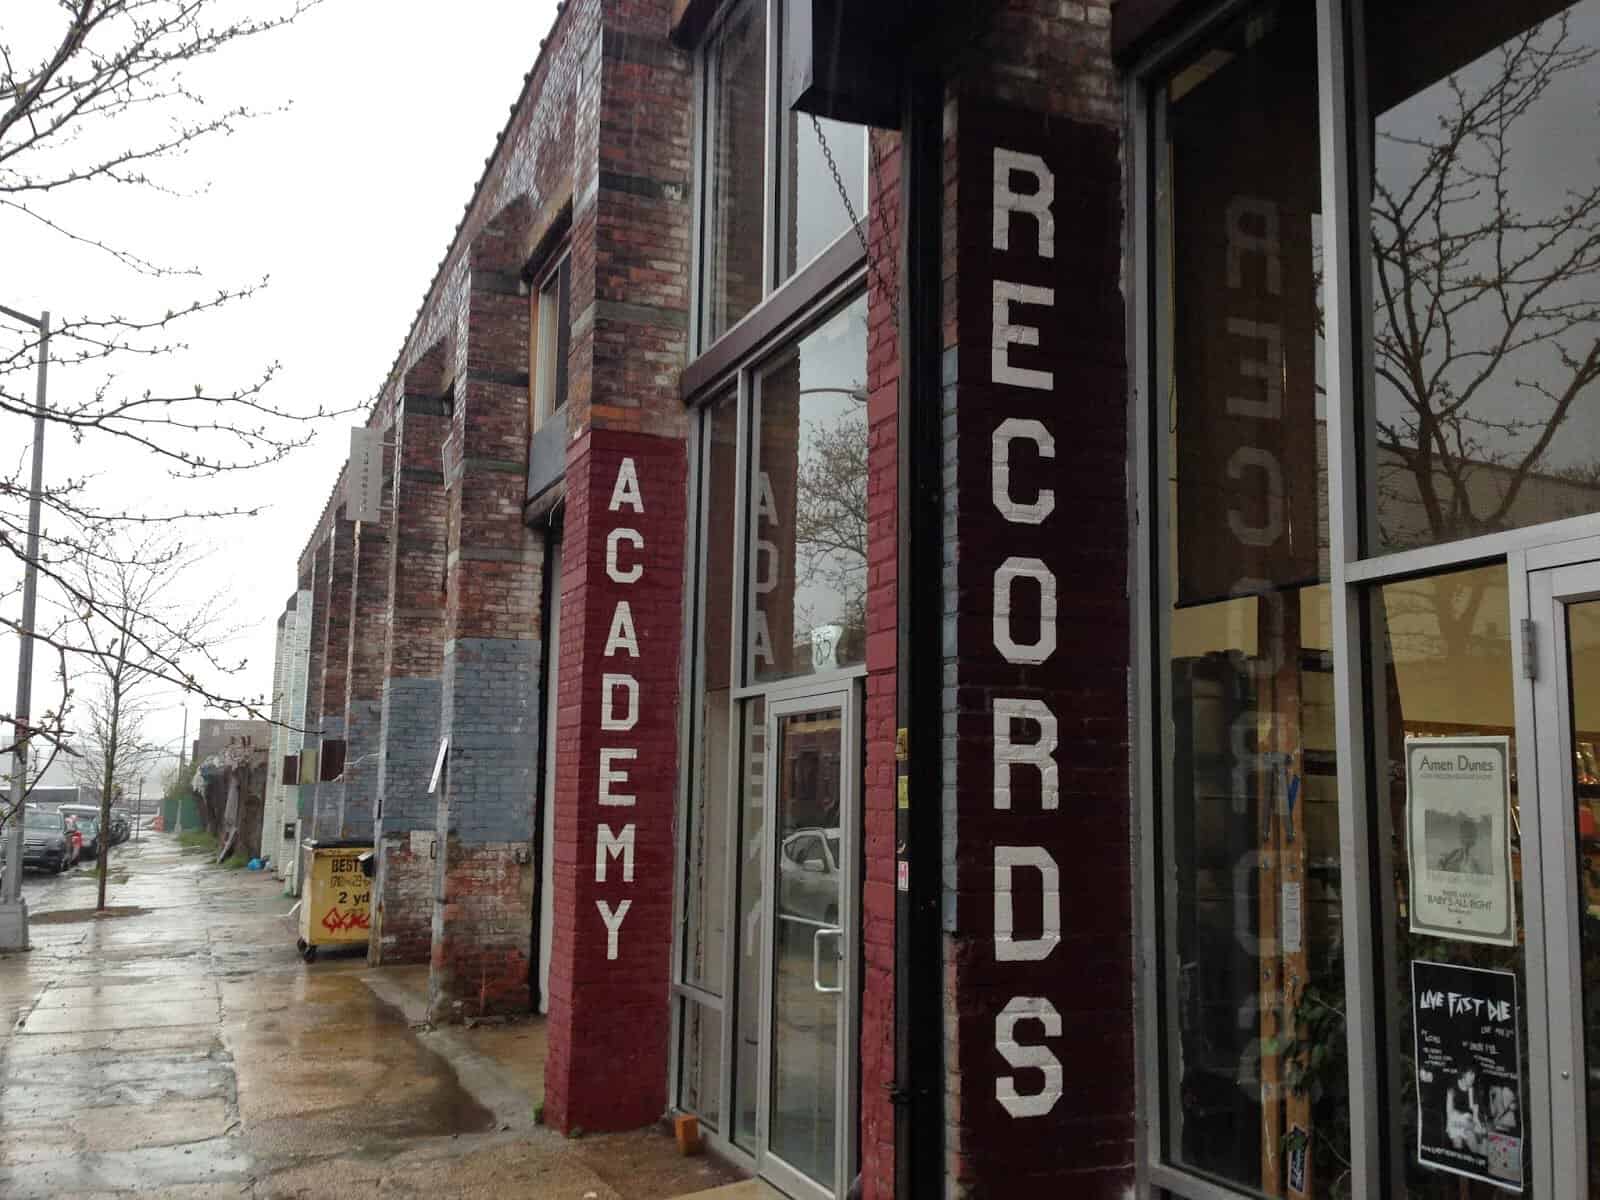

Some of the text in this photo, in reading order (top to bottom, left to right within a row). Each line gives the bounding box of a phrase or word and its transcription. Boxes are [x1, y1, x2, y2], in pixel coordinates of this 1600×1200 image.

[992, 147, 1063, 1118] RECORDS
[816, 633, 831, 665] 85
[595, 457, 645, 960] ACADEMY
[1420, 754, 1495, 771] Amen Dunes
[331, 858, 360, 873] BEST
[339, 892, 348, 904] 2
[1420, 989, 1511, 1021] LIVE FAST DIE
